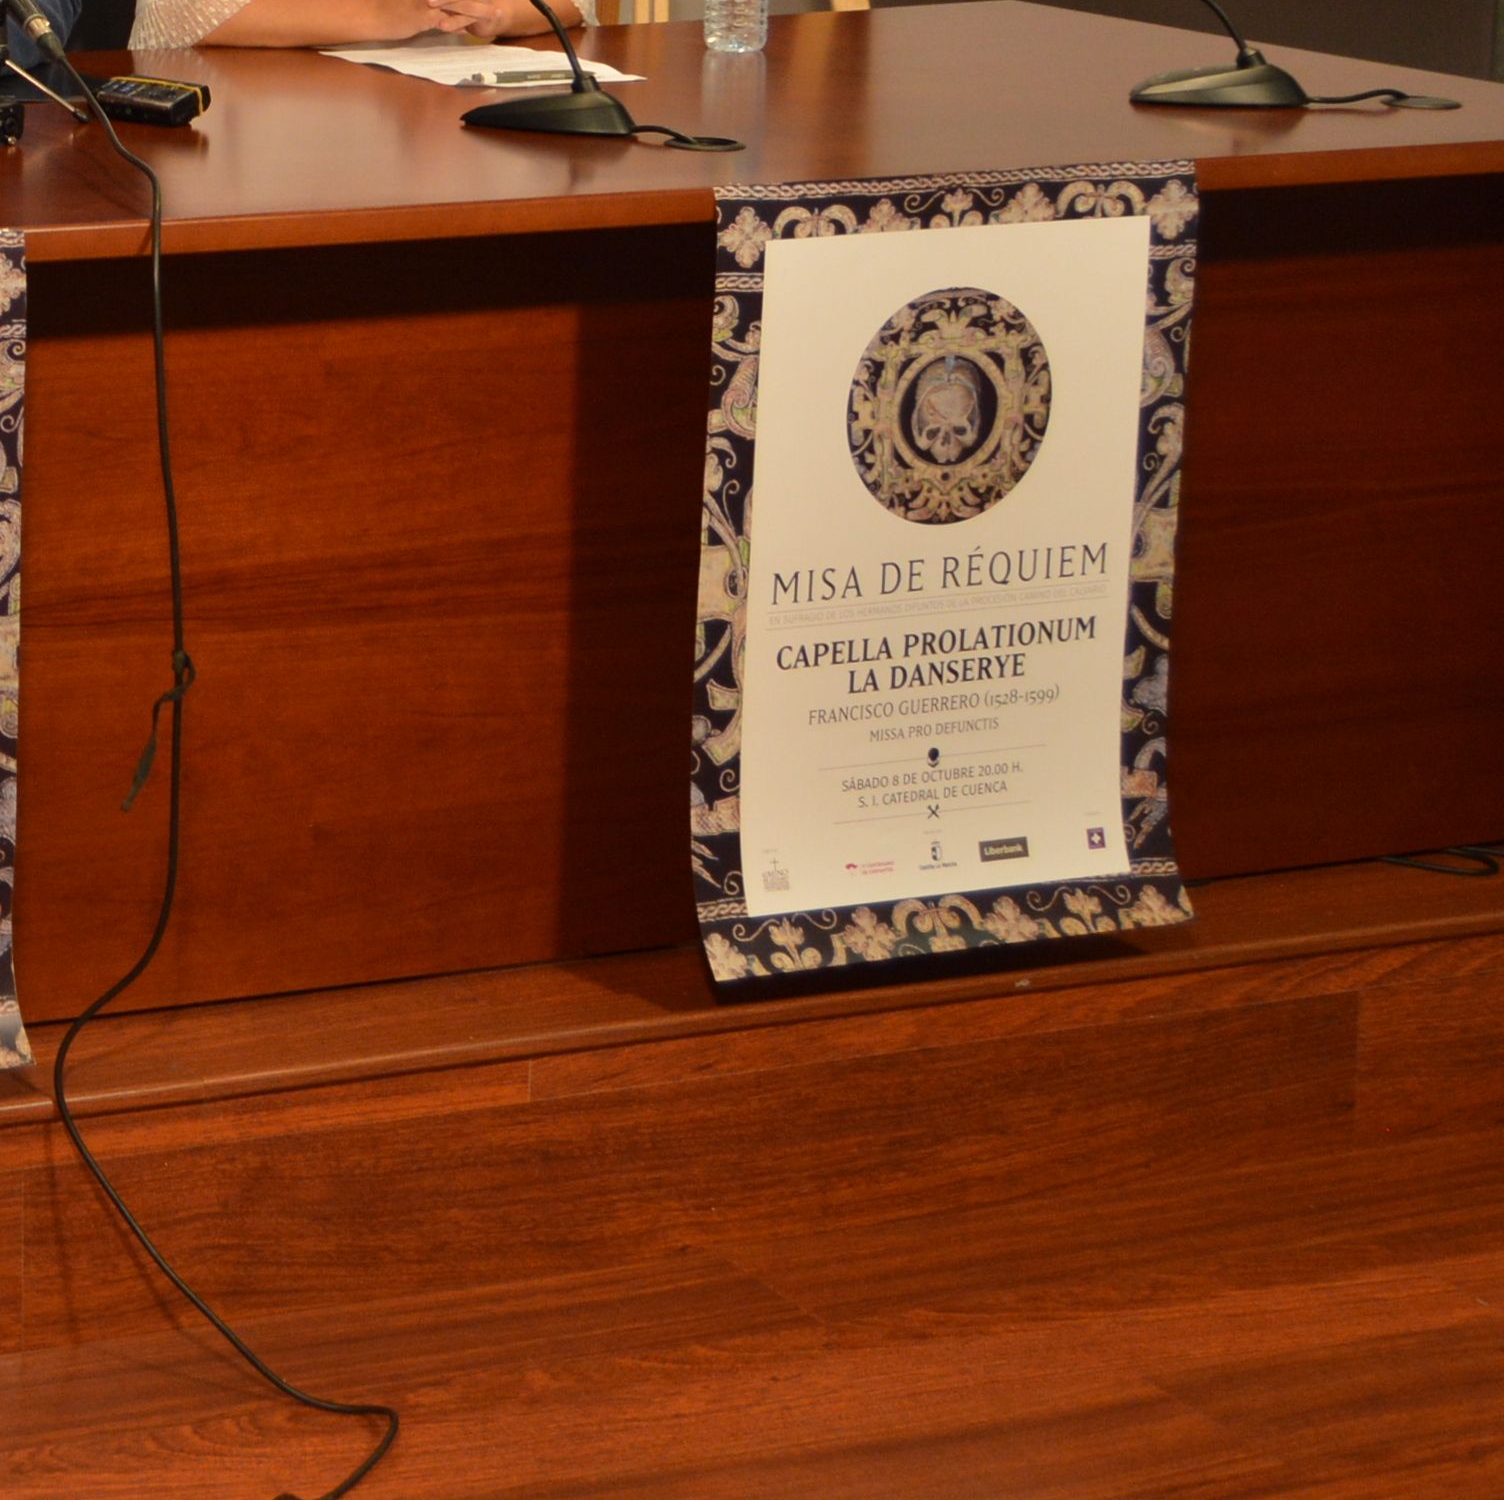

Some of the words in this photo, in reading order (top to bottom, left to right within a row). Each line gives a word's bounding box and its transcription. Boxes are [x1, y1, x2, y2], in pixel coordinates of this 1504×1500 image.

[771, 565, 863, 606] MISA
[880, 558, 926, 595] DE
[941, 541, 1108, 590] RÉQUIEM
[776, 636, 894, 671] CAPELLA
[903, 615, 1097, 658] PROLATIONUM
[847, 668, 880, 694] LA
[889, 652, 1026, 691] DANSERYE
[808, 701, 894, 726] FRANCISCO
[898, 692, 980, 716] GUERRERO
[984, 682, 1060, 710] (1528-1599)
[869, 727, 905, 742] MISSA
[908, 723, 932, 738] PRO
[935, 716, 1000, 735] DEFUNCTIS
[842, 775, 889, 793] SÁBADO
[892, 774, 900, 786] 8
[903, 772, 918, 785] DE
[921, 765, 975, 783] OCTUBRE
[977, 762, 1009, 777] 20.00
[1011, 761, 1024, 773] H.
[858, 796, 869, 808] S.
[882, 788, 939, 806] CATEDRAL
[943, 786, 958, 799] DE
[961, 780, 1008, 797] CUENCA
